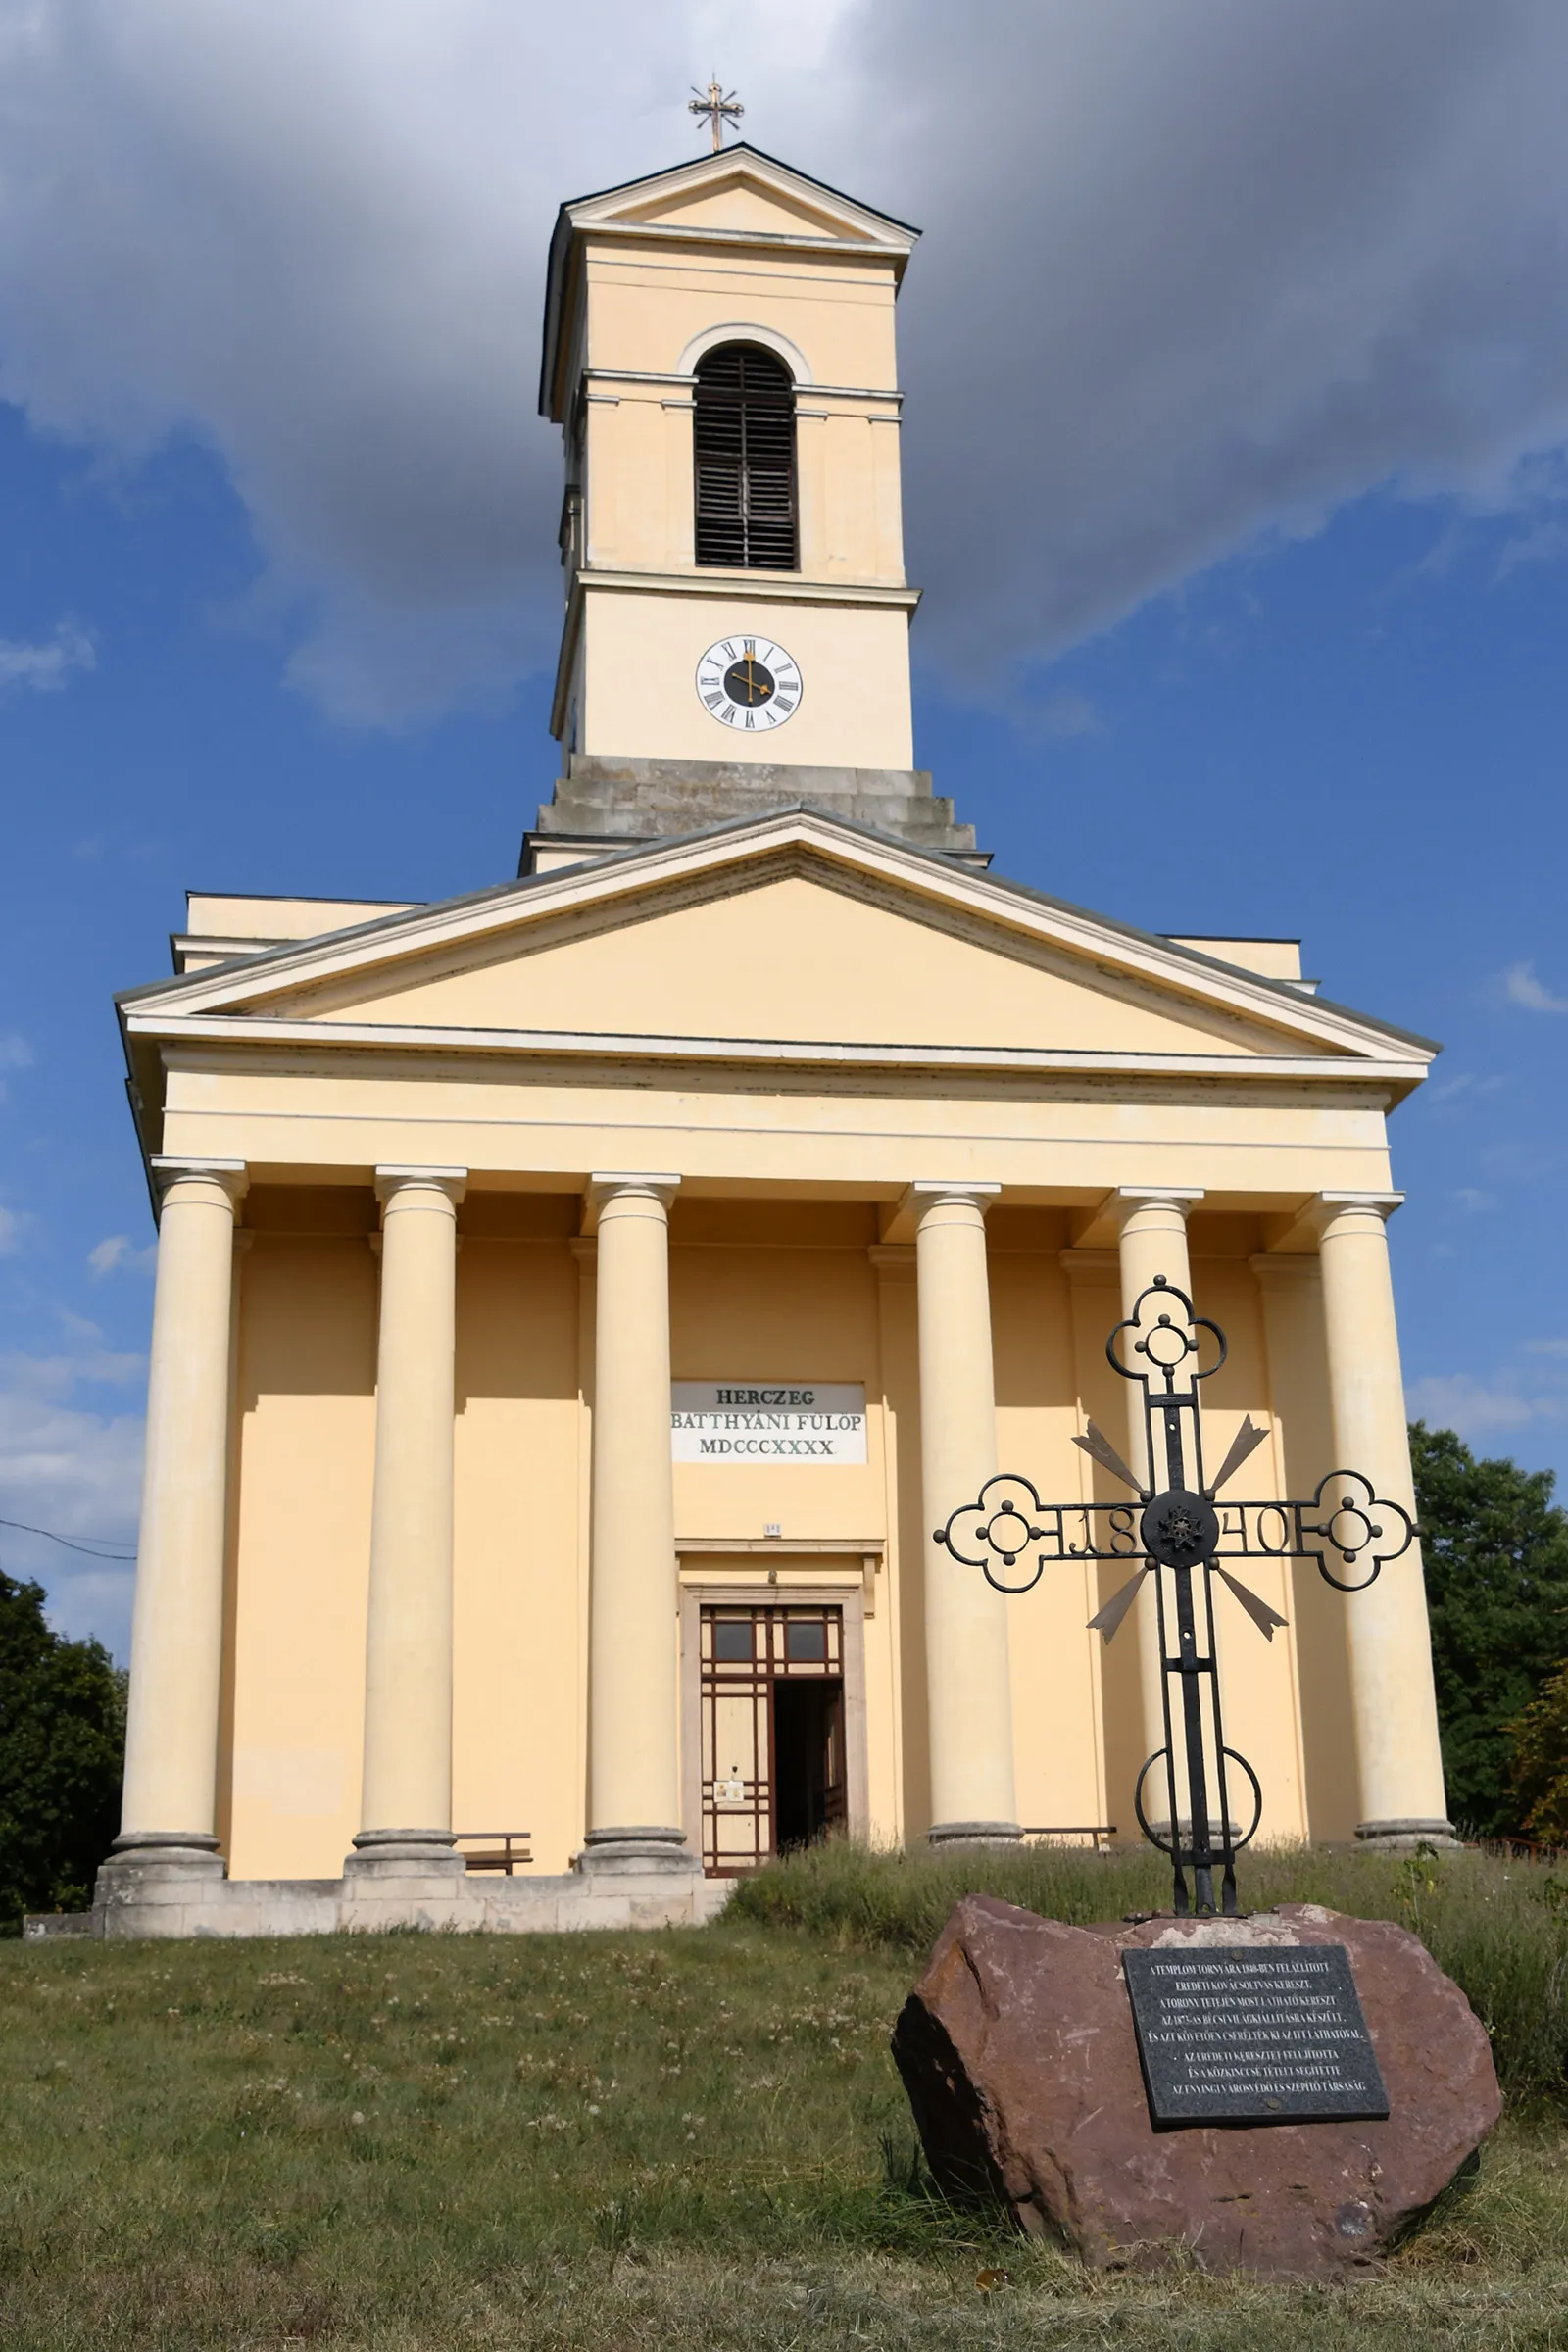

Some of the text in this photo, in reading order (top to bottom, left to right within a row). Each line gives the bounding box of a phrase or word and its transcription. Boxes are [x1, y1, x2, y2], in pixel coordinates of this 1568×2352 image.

[716, 1389, 815, 1405] HERCZEG
[671, 1410, 789, 1430] BATTHYÁNI
[1150, 1965, 1156, 1975] A
[1155, 1963, 1196, 1975] TEMPLOM
[1197, 1961, 1242, 1974] TORNYÁRA
[1275, 1960, 1329, 1973] FELÁLLÍTOTT
[1175, 1982, 1209, 1991] EREDETI
[1210, 1978, 1273, 1990] KOVÁCSOLTVAS
[1160, 1993, 1336, 2008] A TORONY TETEJÉN MOST LÁTHATÓ KERESZT
[1161, 2015, 1172, 2025] AZ
[1202, 2012, 1226, 2024] BÉCSI
[1148, 2030, 1158, 2042] ÉS
[1160, 2033, 1175, 2042] AZT
[1176, 2030, 1222, 2041] KÖVETŐEN
[1222, 2029, 1270, 2040] CSERÉLTÉK
[1270, 2031, 1280, 2040] KI
[1282, 2031, 1291, 2040] AZ
[1293, 2030, 1306, 2039] ITT
[1184, 2052, 1195, 2062] AZ
[1196, 2052, 1232, 2062] EREDETI
[1233, 2050, 1280, 2061] KERESZTET
[1188, 2066, 1199, 2078] ÉS
[1200, 2068, 1206, 2078] A
[1263, 2065, 1294, 2076] TÉTELT
[1295, 2063, 1340, 2075] SEGÍTETTE
[1172, 2085, 1182, 2094] AZ
[1184, 2084, 1221, 2094] ENYINGI
[1274, 2081, 1285, 2092] ÉS
[1285, 2080, 1321, 2092] SZÉPÍTŐ
